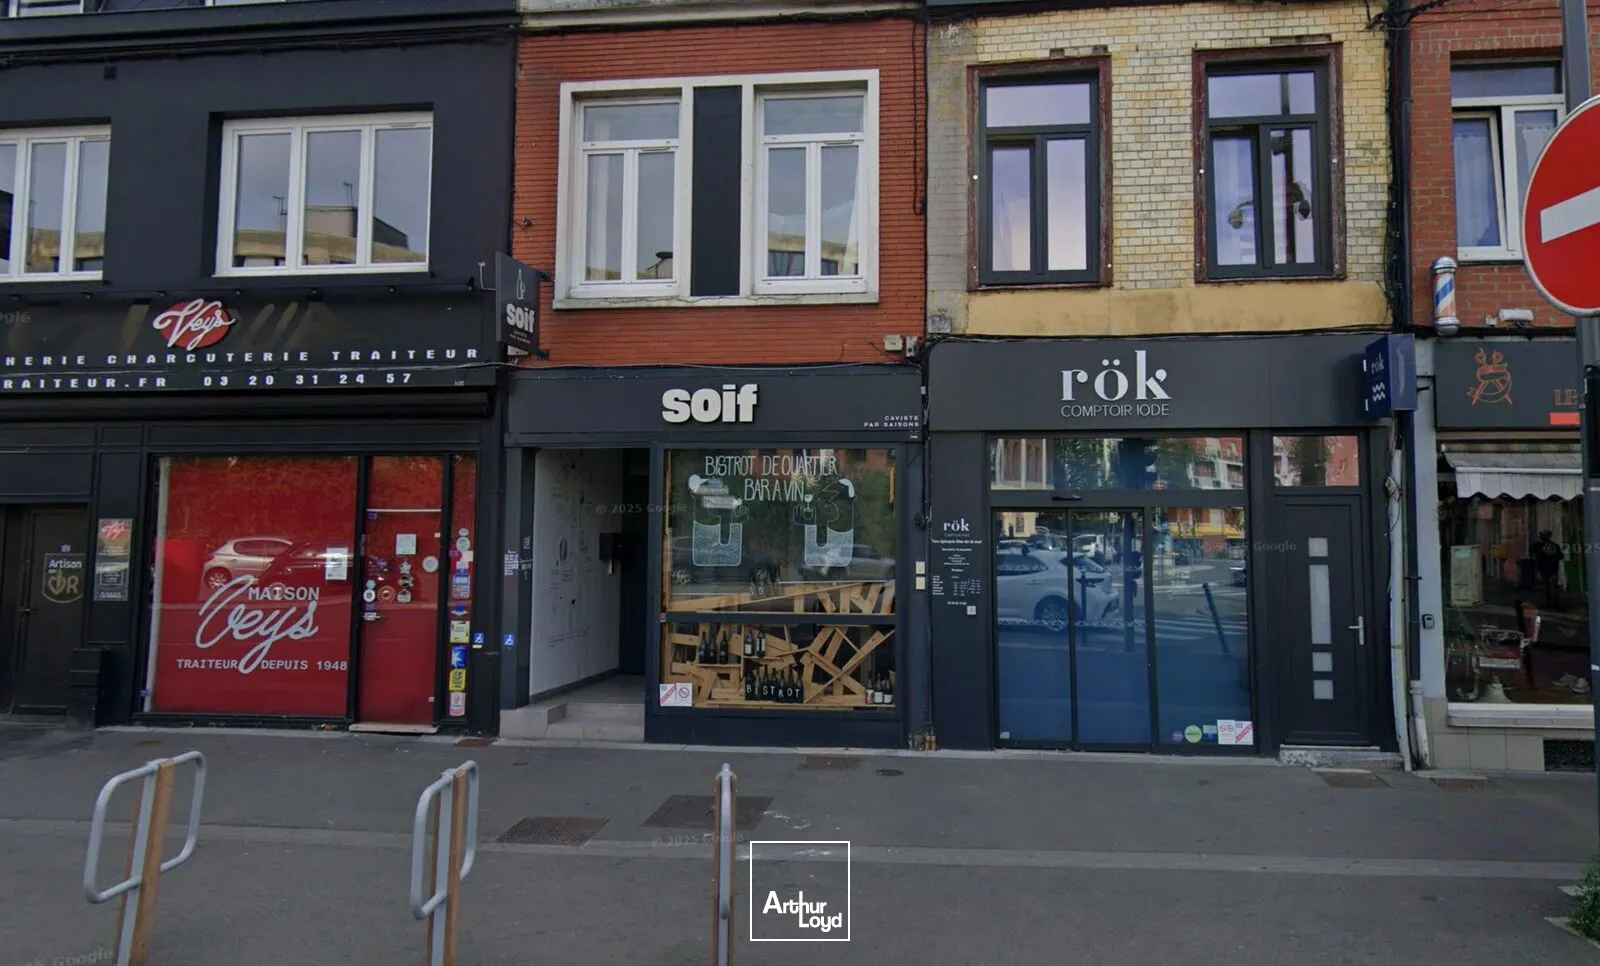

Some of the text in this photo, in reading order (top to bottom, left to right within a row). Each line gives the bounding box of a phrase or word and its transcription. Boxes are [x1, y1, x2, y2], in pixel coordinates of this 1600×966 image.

[153, 298, 237, 351] Veys
[107, 351, 309, 365] CHARCUTERIE
[332, 349, 477, 361] TRAITEUR
[203, 376, 229, 387] 03
[249, 375, 275, 386] 20
[295, 374, 319, 385] 31
[339, 374, 365, 384] 24
[386, 373, 412, 383] 57
[1060, 349, 1172, 401] rök
[661, 384, 758, 423] soif
[1060, 403, 1170, 418] COMPTOIR IODE
[704, 455, 756, 476] BISTROT
[762, 455, 780, 476] DE
[744, 478, 770, 501] BAR
[783, 478, 805, 501] VIN
[943, 518, 970, 531] rök
[248, 587, 320, 601] MAISON
[196, 575, 319, 674] Veys
[176, 659, 348, 671] TRAITEUR DEPUIS 1948
[746, 684, 800, 699] BISTROT
